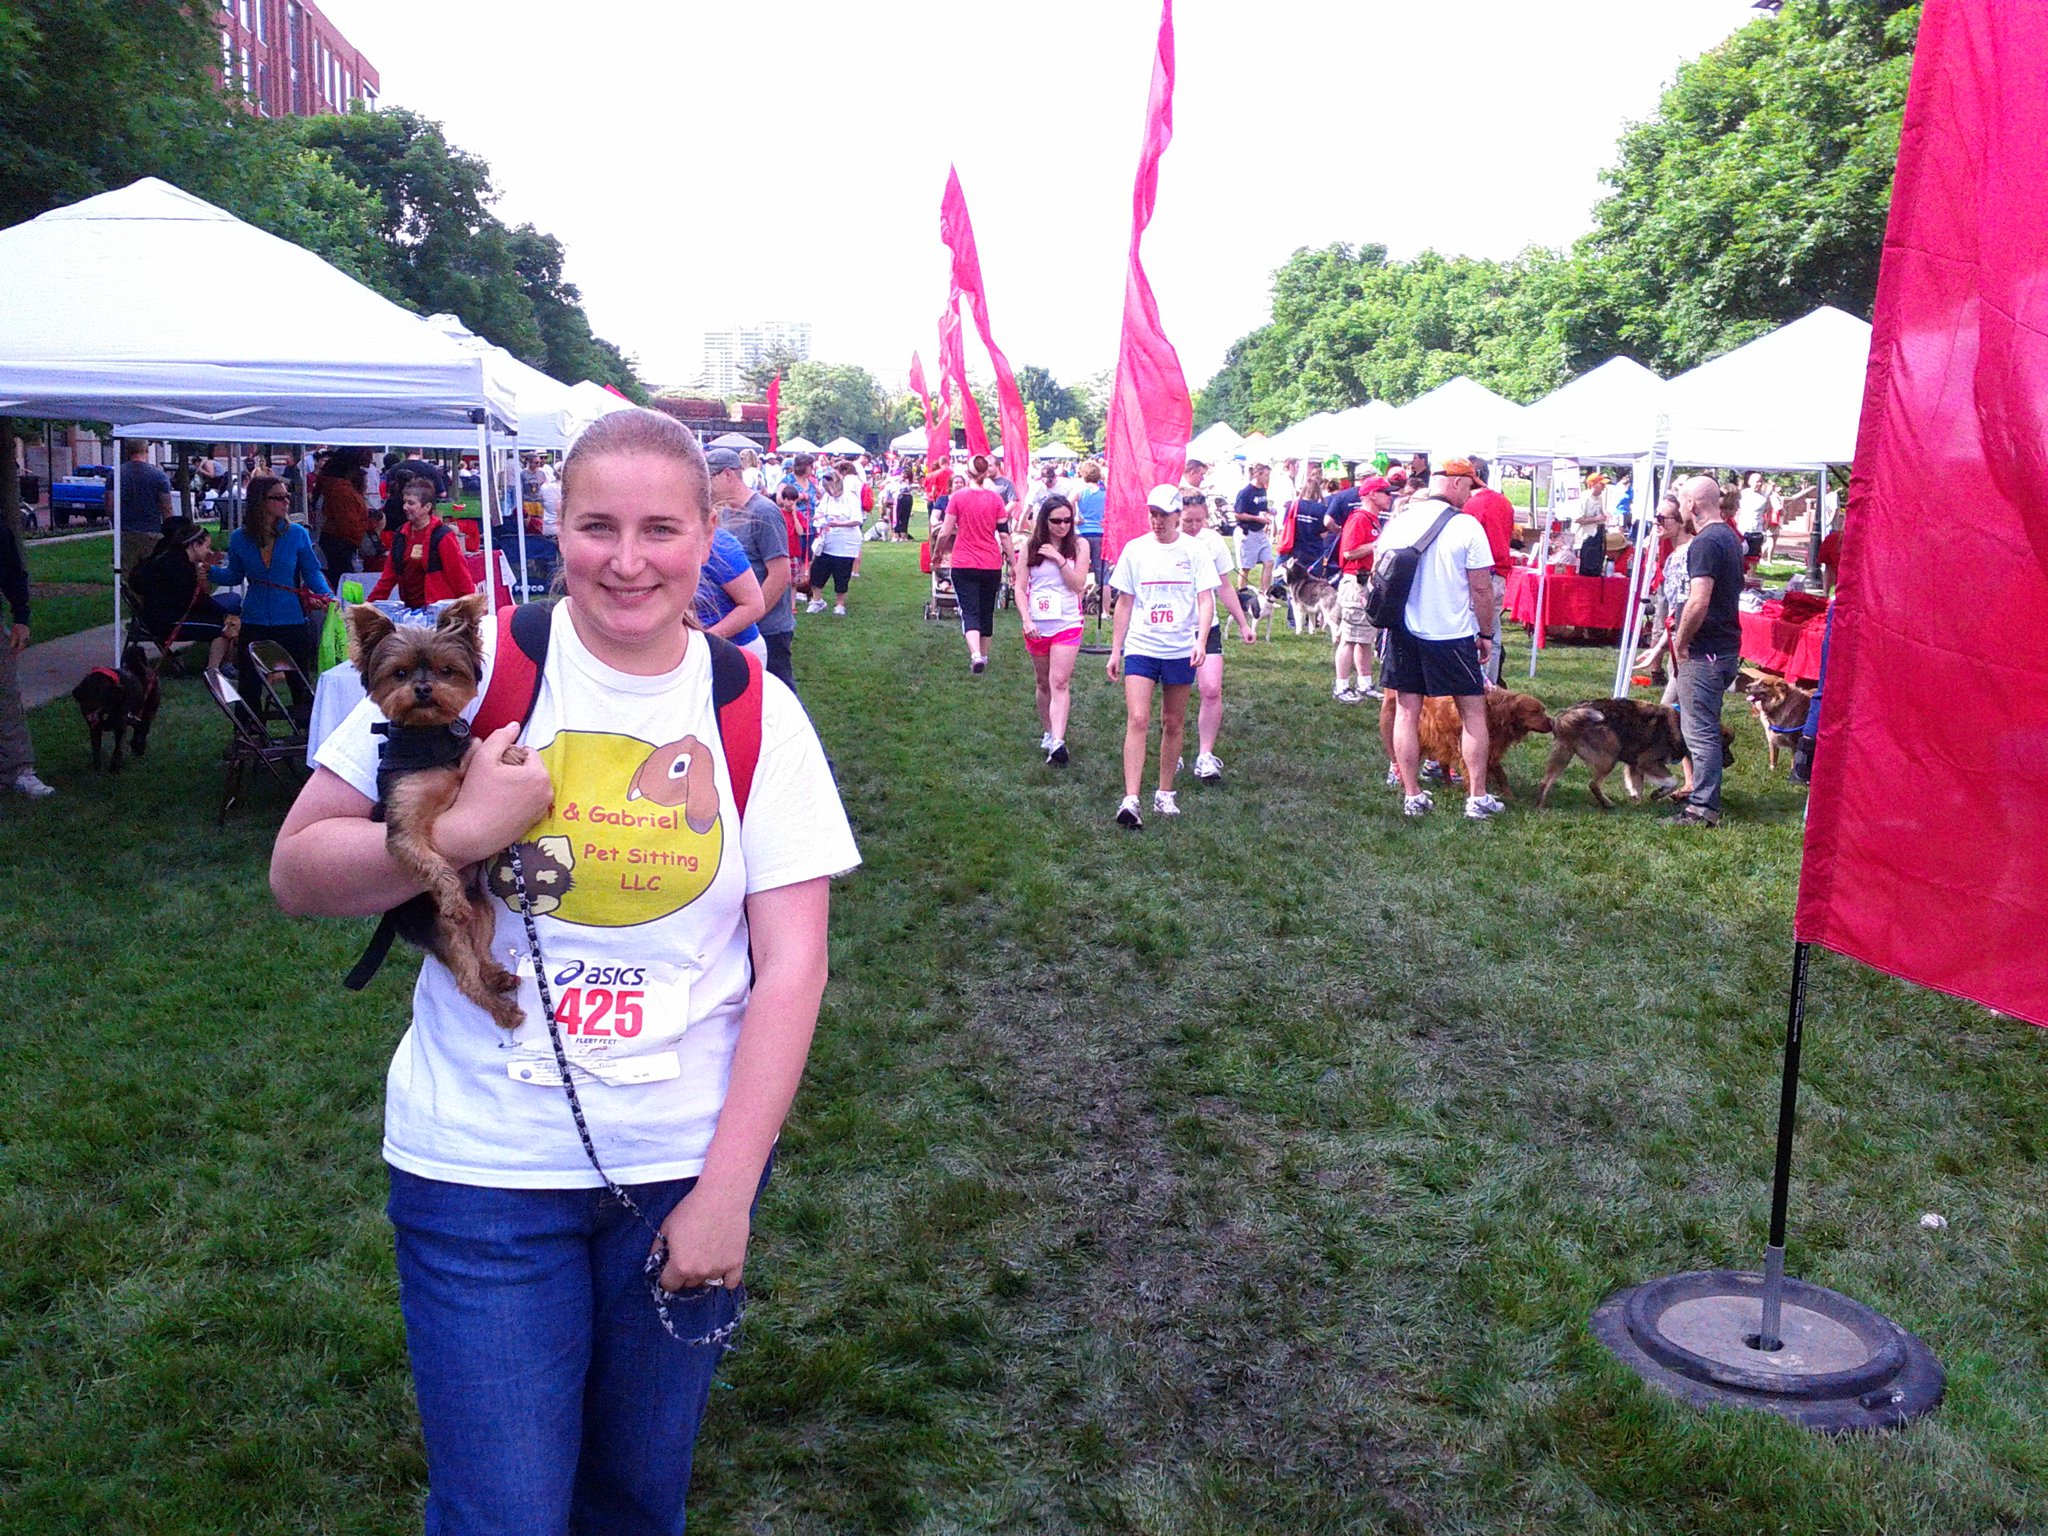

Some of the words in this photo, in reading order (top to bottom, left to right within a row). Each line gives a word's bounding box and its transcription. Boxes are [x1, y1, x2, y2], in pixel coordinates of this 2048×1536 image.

[1151, 610, 1173, 623] 676
[562, 802, 580, 822] &
[589, 806, 678, 830] Gabriel
[583, 843, 619, 861] Pet
[627, 848, 699, 872] Sitting
[620, 873, 662, 891] LLC
[553, 987, 645, 1038] 425
[599, 1037, 618, 1045] FEET
